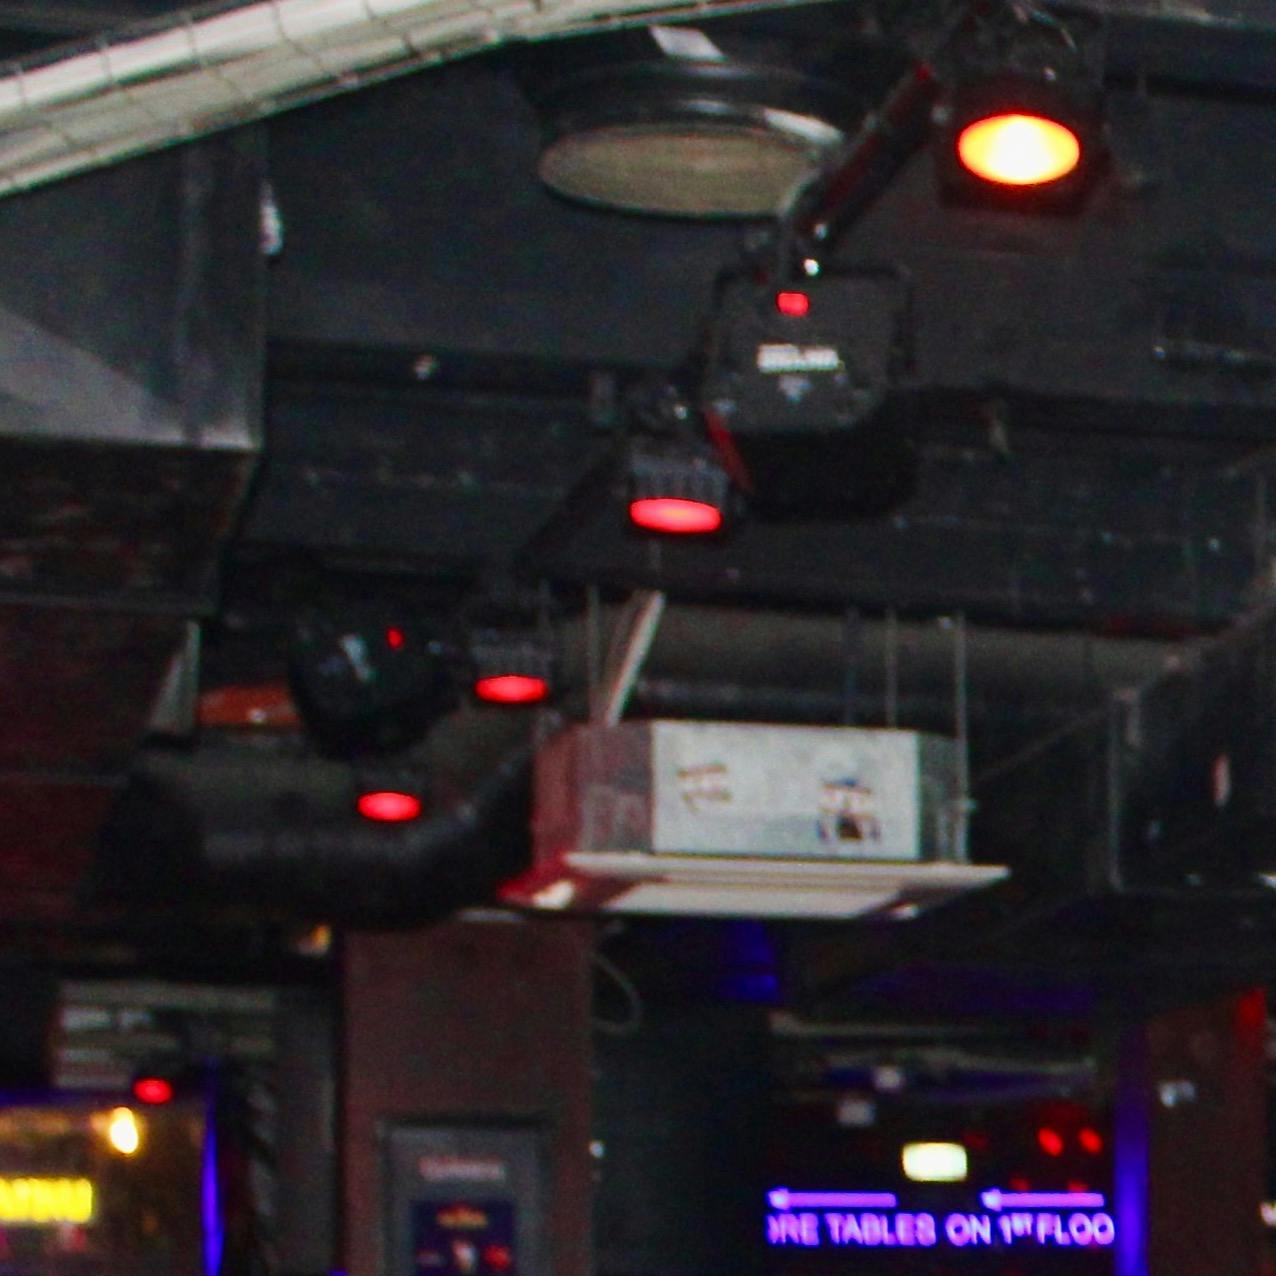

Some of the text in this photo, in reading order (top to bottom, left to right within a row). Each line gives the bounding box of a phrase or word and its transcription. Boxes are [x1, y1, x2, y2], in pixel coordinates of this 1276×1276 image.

[824, 1212, 938, 1247] TABLES
[945, 1212, 992, 1247] ON
[1036, 1212, 1116, 1247] FLOO
